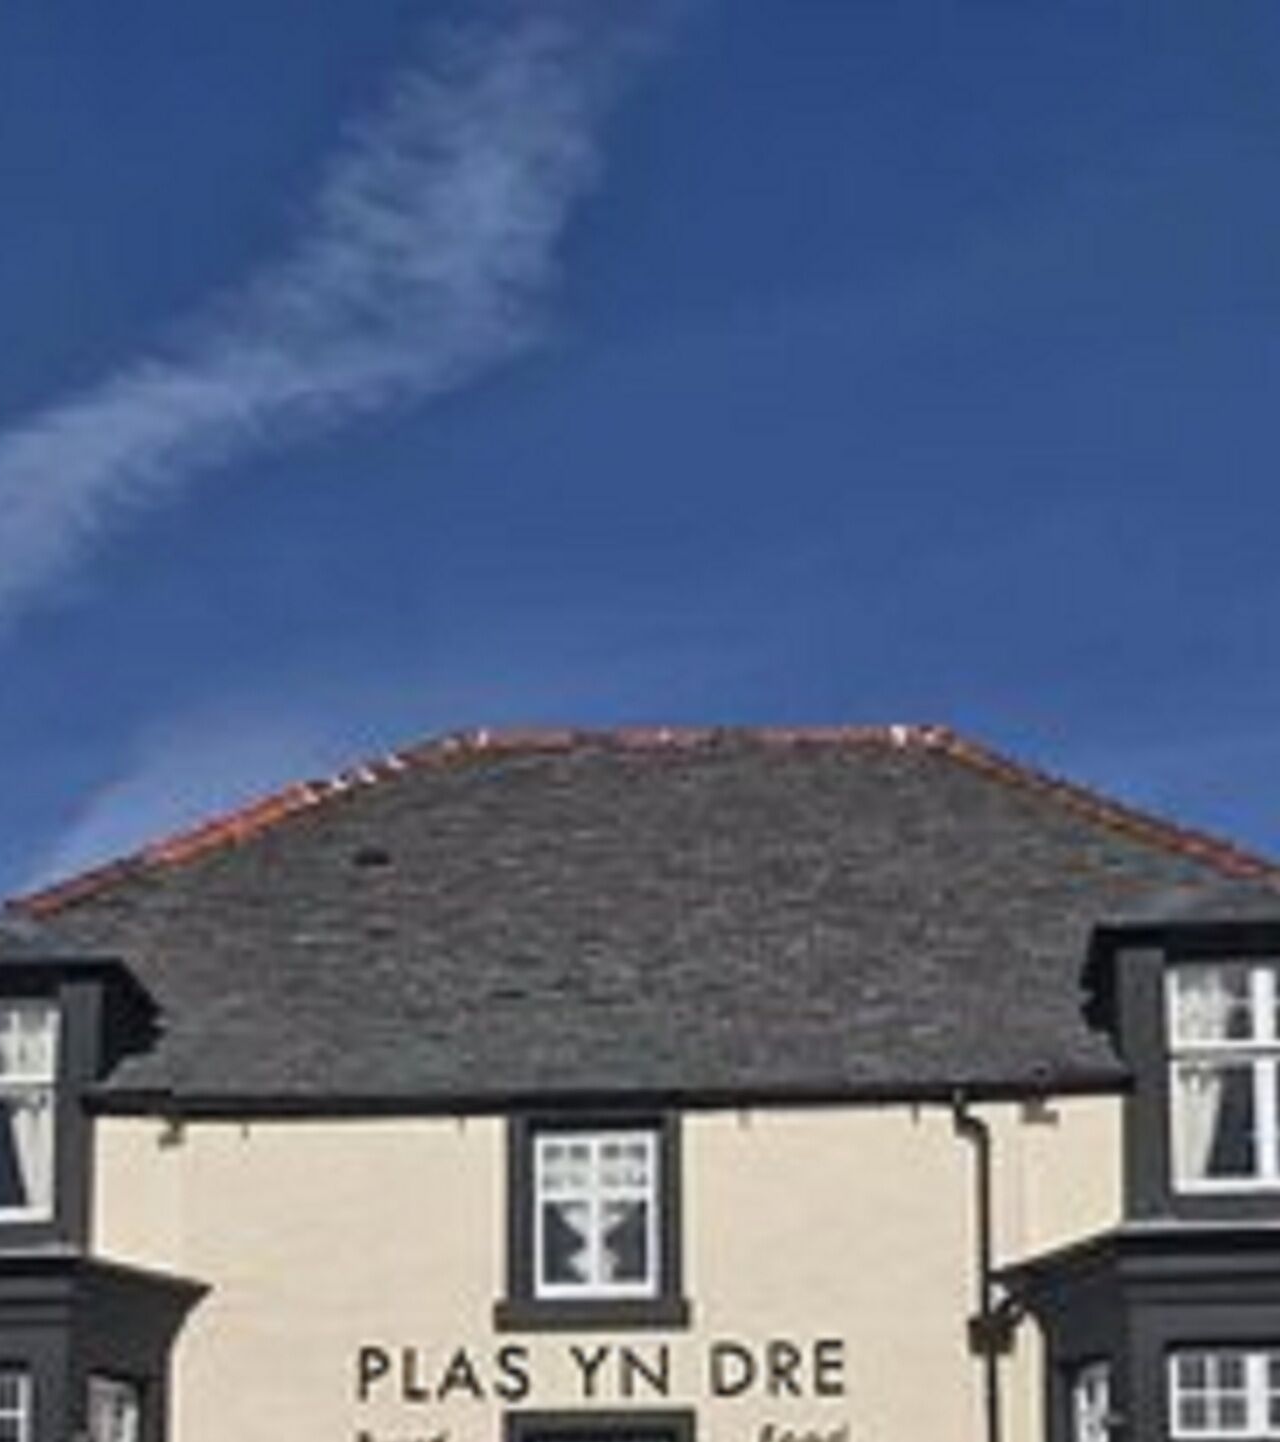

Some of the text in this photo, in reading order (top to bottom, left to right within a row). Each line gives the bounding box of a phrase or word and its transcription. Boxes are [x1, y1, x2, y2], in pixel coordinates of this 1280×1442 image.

[357, 1339, 845, 1402] PLAS YN DRE
